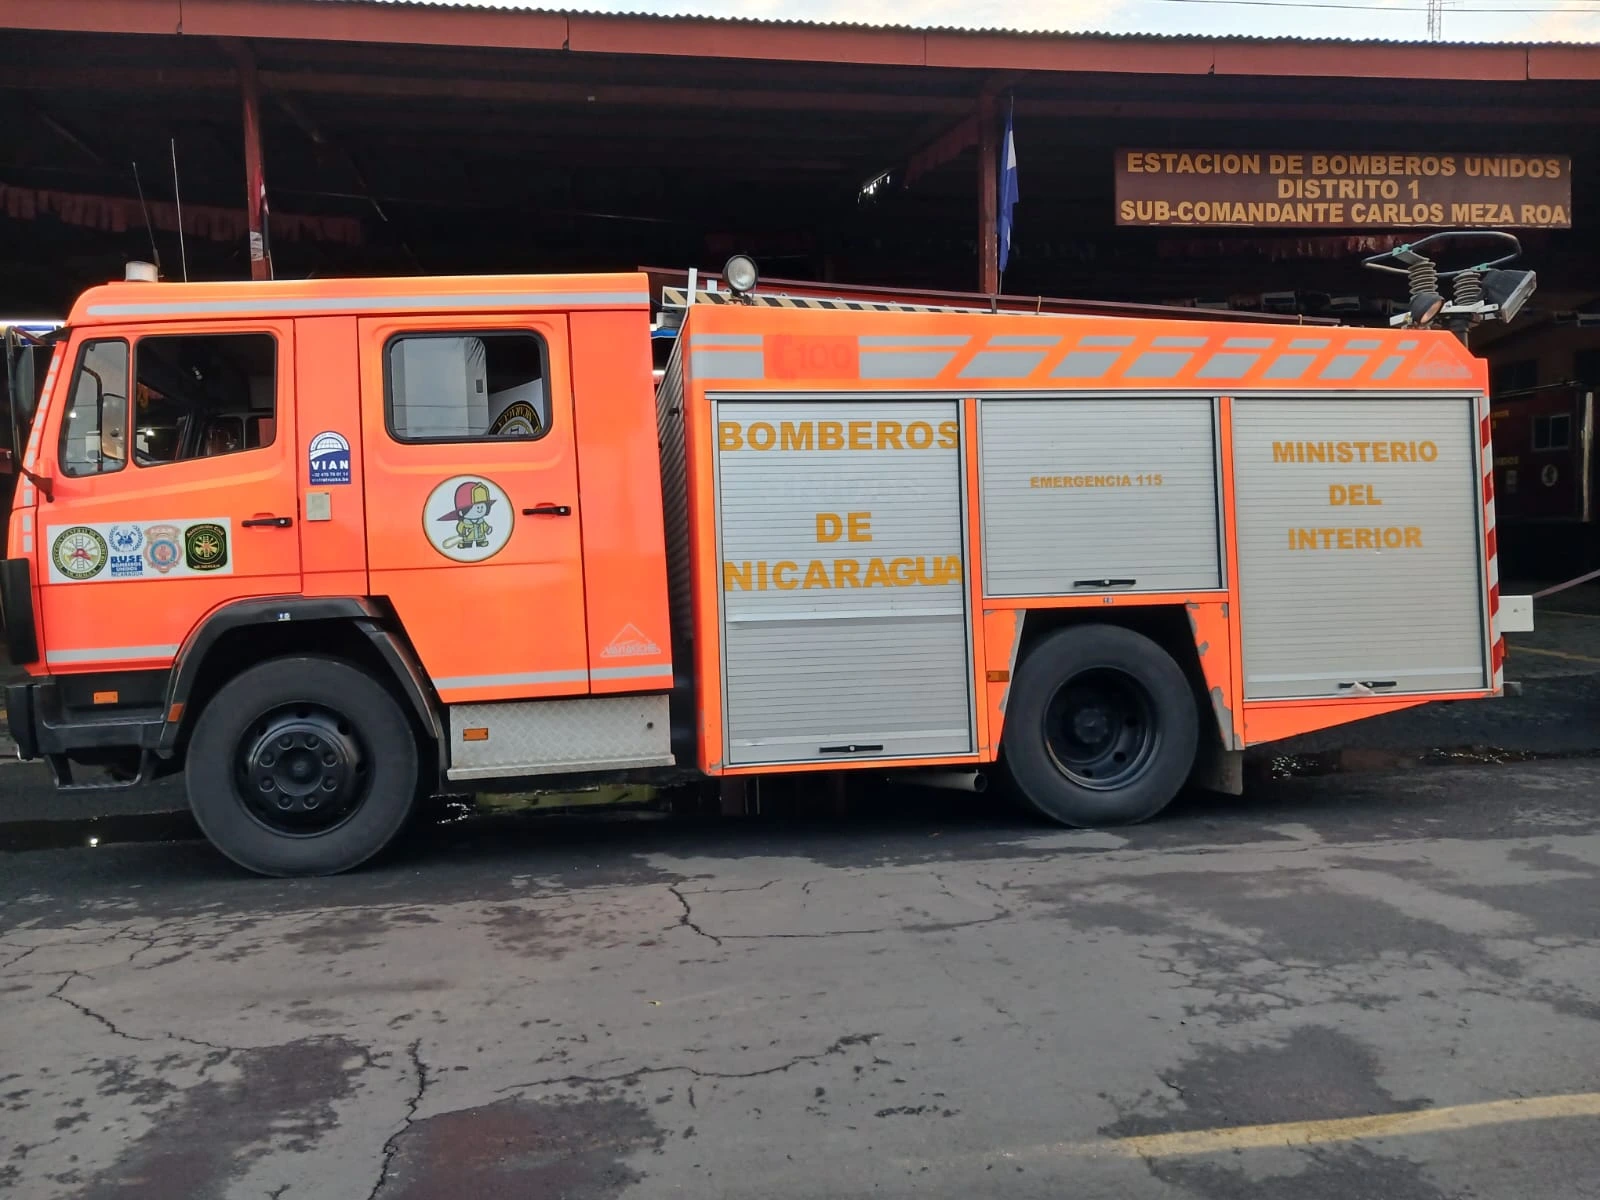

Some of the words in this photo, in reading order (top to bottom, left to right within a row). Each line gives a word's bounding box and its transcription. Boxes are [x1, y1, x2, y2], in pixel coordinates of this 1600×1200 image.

[1126, 152, 1260, 174] ESTACION
[1269, 154, 1304, 175] DE
[1311, 155, 1456, 177] BOMBEROS
[1464, 157, 1561, 179] UNIDOS
[1277, 178, 1399, 200] DISTRITO
[1407, 179, 1420, 200] 1
[1120, 200, 1344, 224] SUB-COMANDANTE
[1350, 202, 1444, 224] CARLOS
[1451, 203, 1515, 225] MEZA
[1520, 204, 1569, 226] ROA
[719, 420, 960, 451] BOMBEROS
[1272, 440, 1439, 463] MINISTERIO
[311, 460, 349, 471] VIAN
[1029, 475, 1131, 489] EMERGENCIA
[1136, 474, 1163, 487] 115
[1328, 484, 1382, 506] DEL
[815, 512, 873, 543] DE
[1287, 526, 1423, 551] INTERIOR
[723, 553, 963, 592] NICARAGUA
